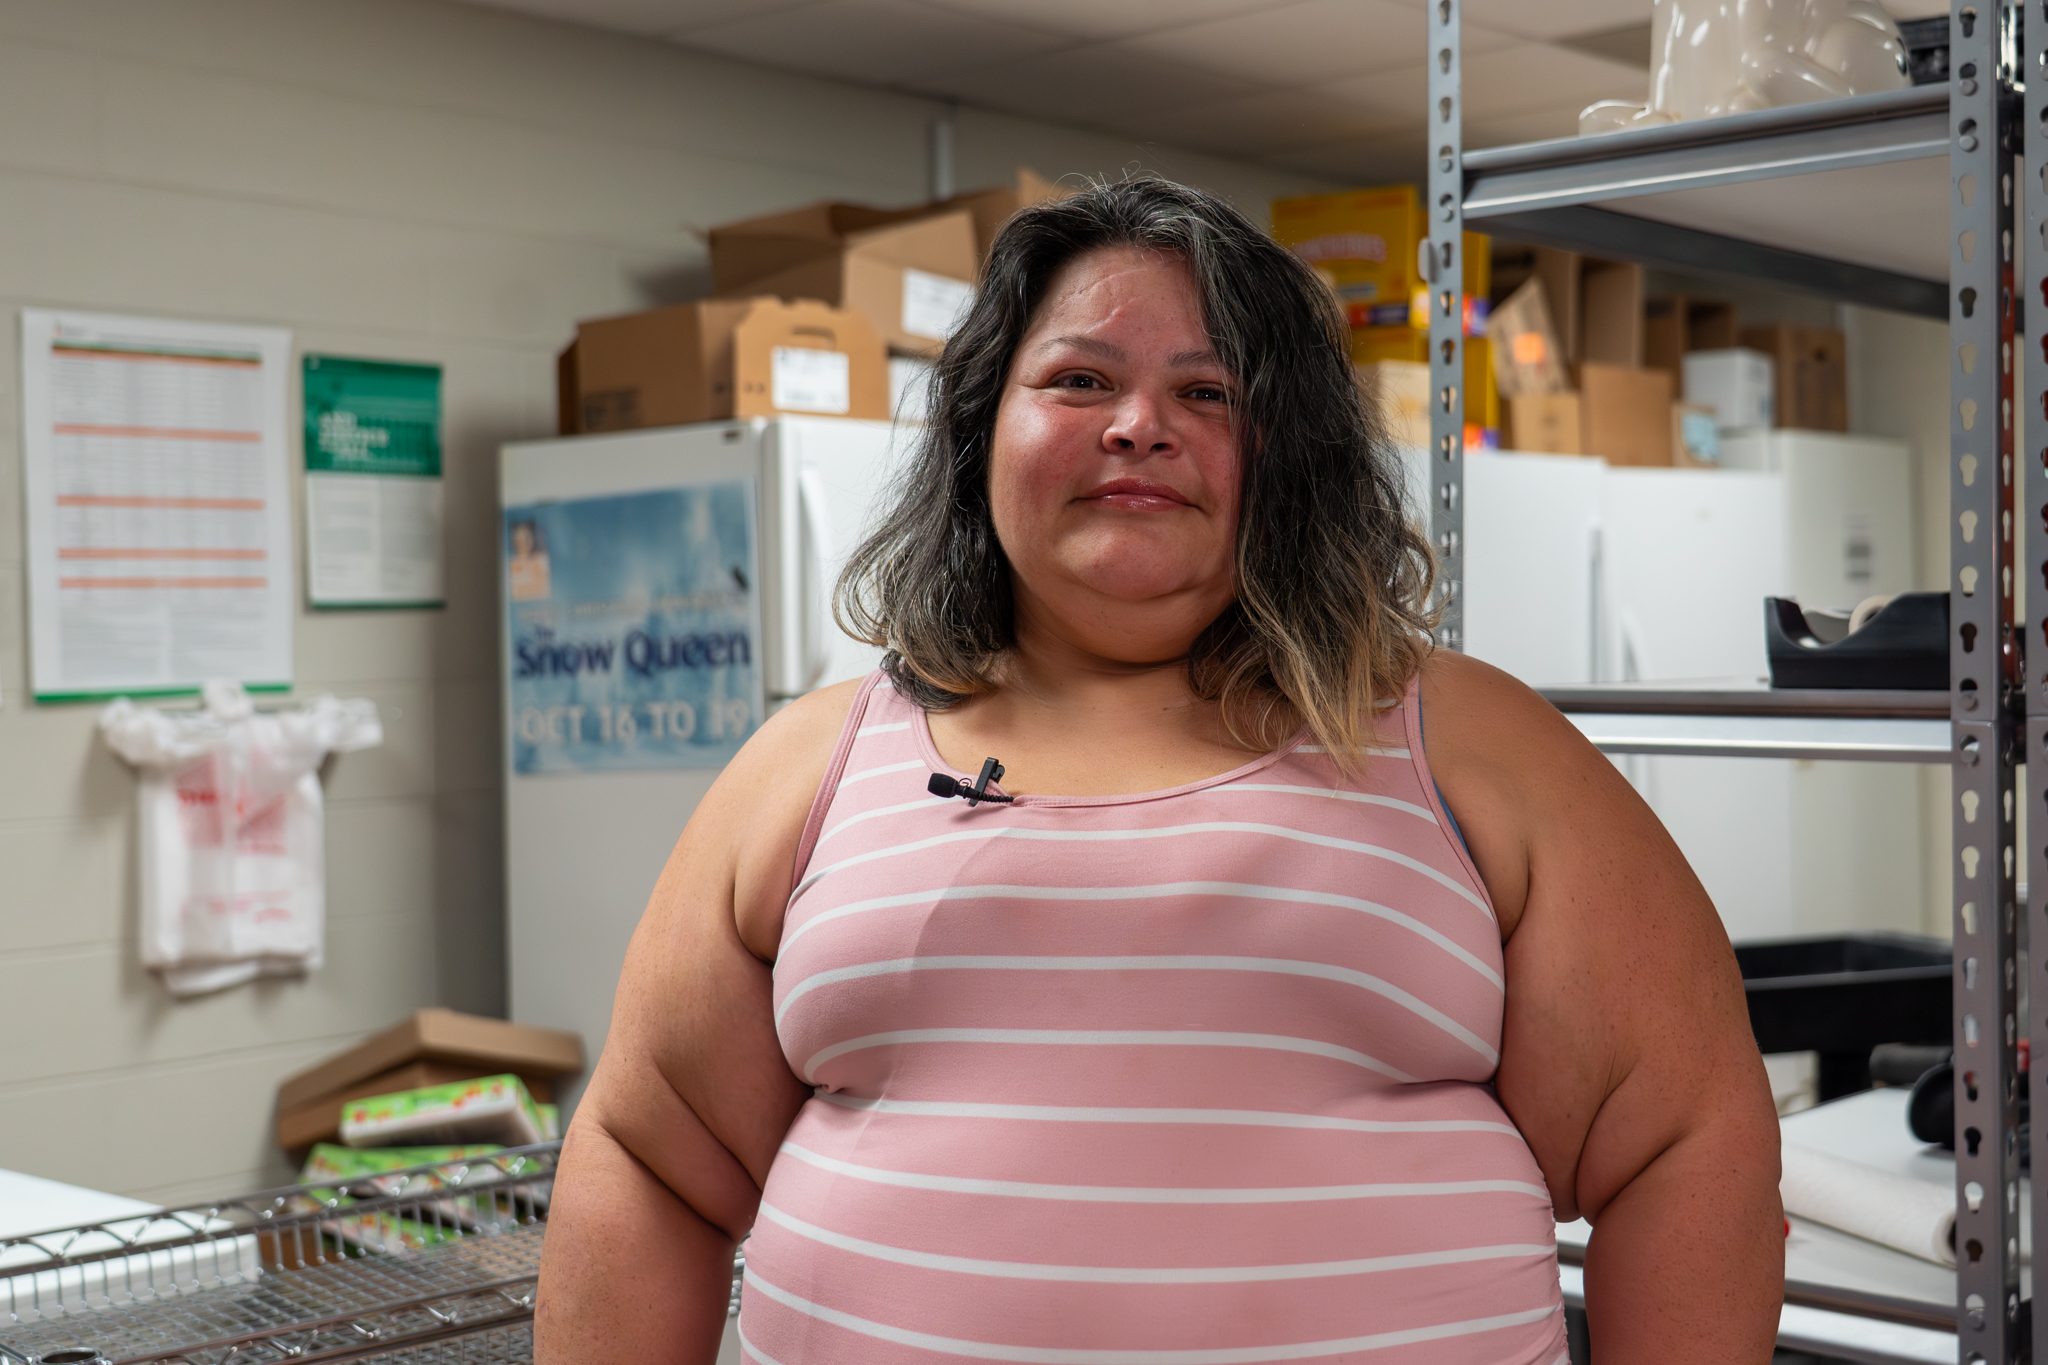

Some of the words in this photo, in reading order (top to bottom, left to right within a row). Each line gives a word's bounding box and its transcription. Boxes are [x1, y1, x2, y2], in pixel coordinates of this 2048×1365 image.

[515, 637, 614, 678] Snow
[624, 628, 754, 678] Queen
[517, 704, 587, 745] OCT
[598, 701, 638, 744] 16
[645, 699, 697, 742] TO
[707, 697, 751, 741] 19
